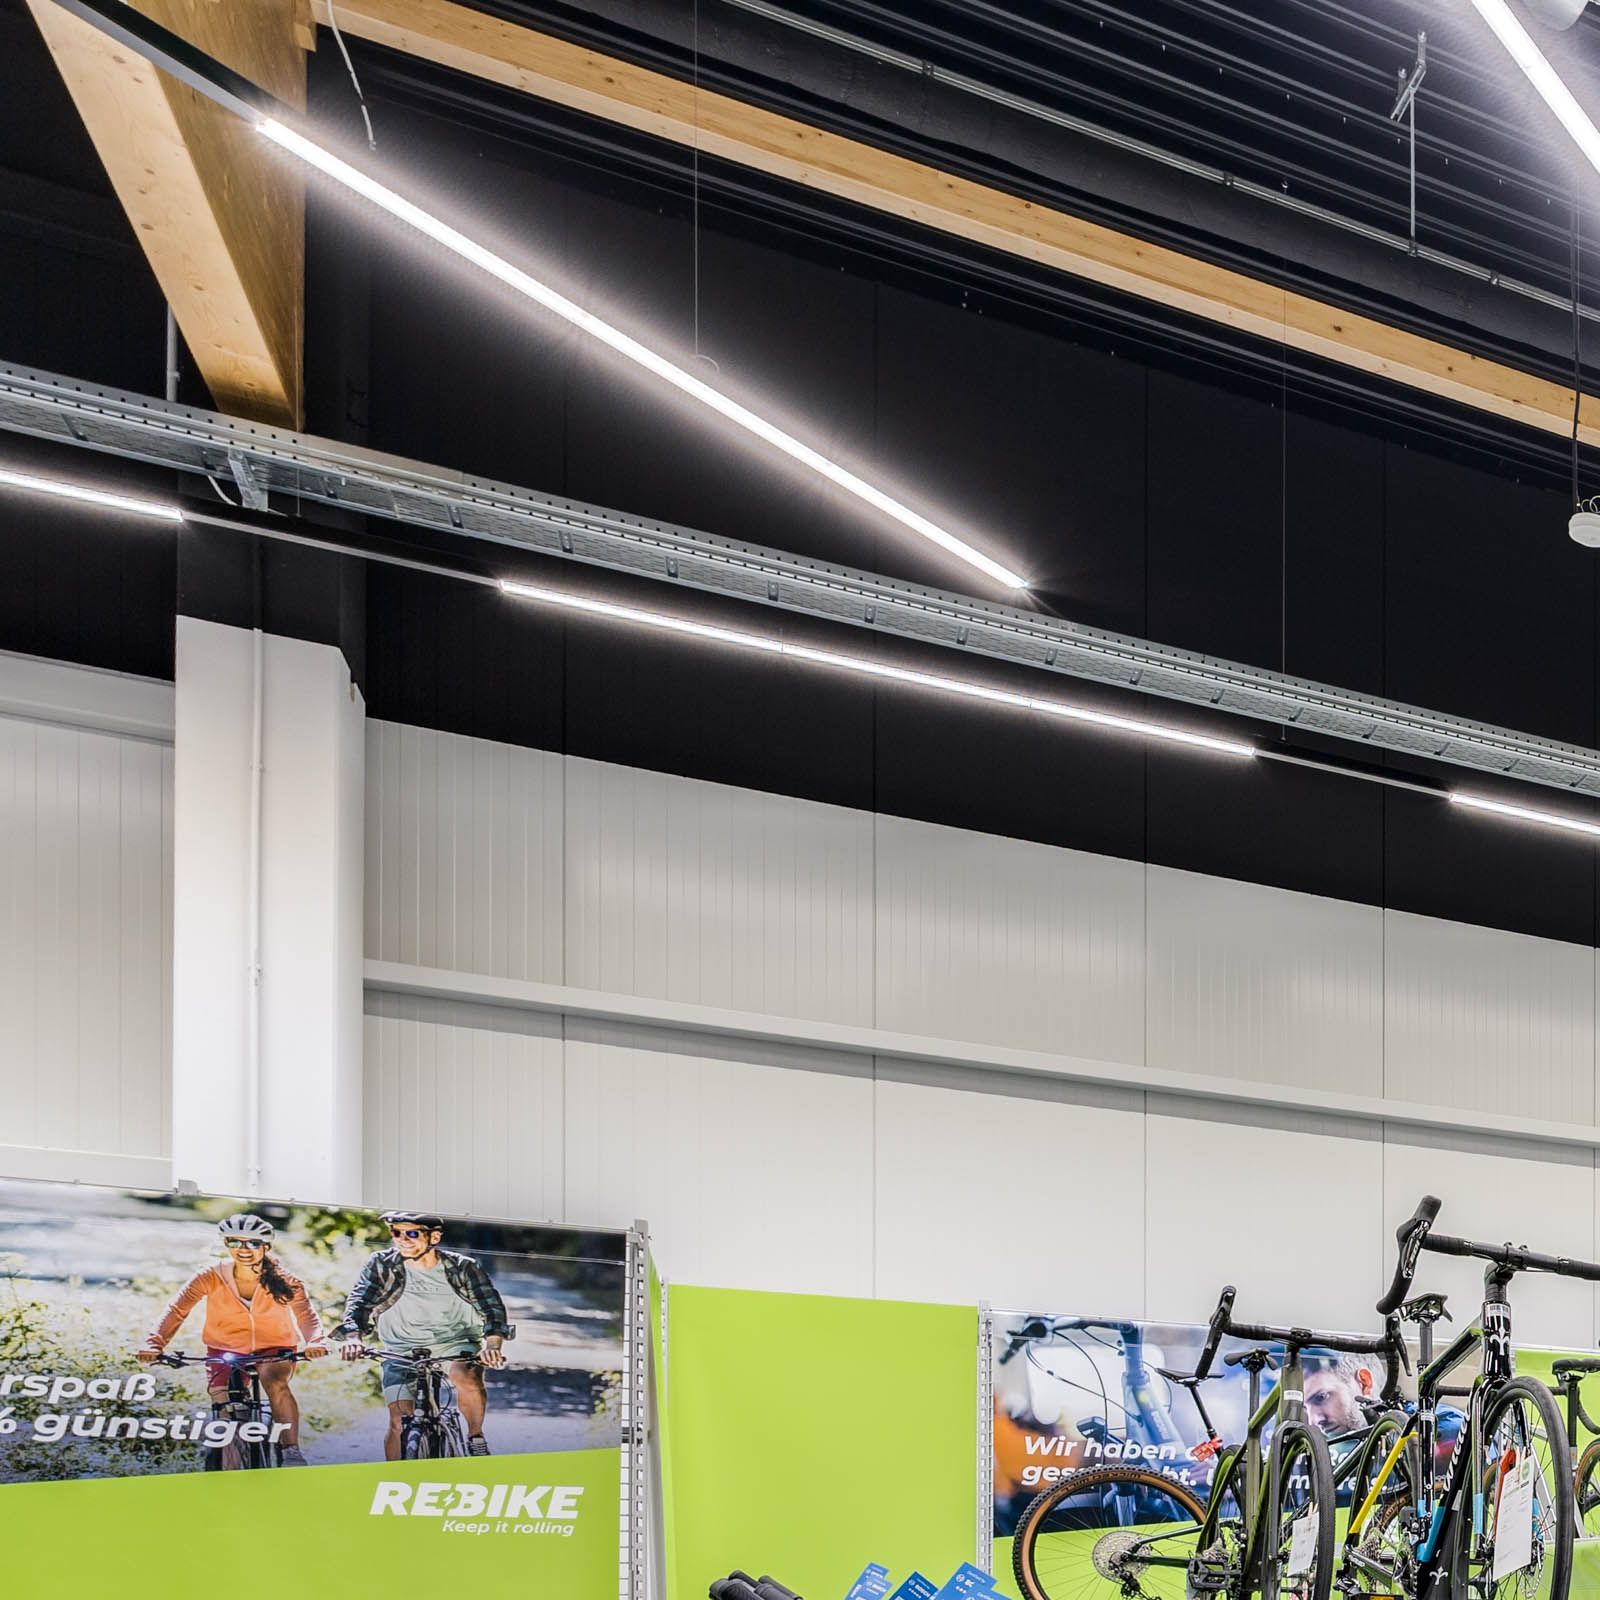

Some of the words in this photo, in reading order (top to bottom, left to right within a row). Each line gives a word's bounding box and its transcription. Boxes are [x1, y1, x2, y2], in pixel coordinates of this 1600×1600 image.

[32, 1408, 291, 1448] günstiger
[1025, 1435, 1077, 1457] Wir
[1083, 1437, 1176, 1460] haben
[369, 1481, 584, 1519] REBIKE
[442, 1520, 490, 1536] Keep
[495, 1520, 508, 1534] it
[513, 1521, 575, 1537] rolling
